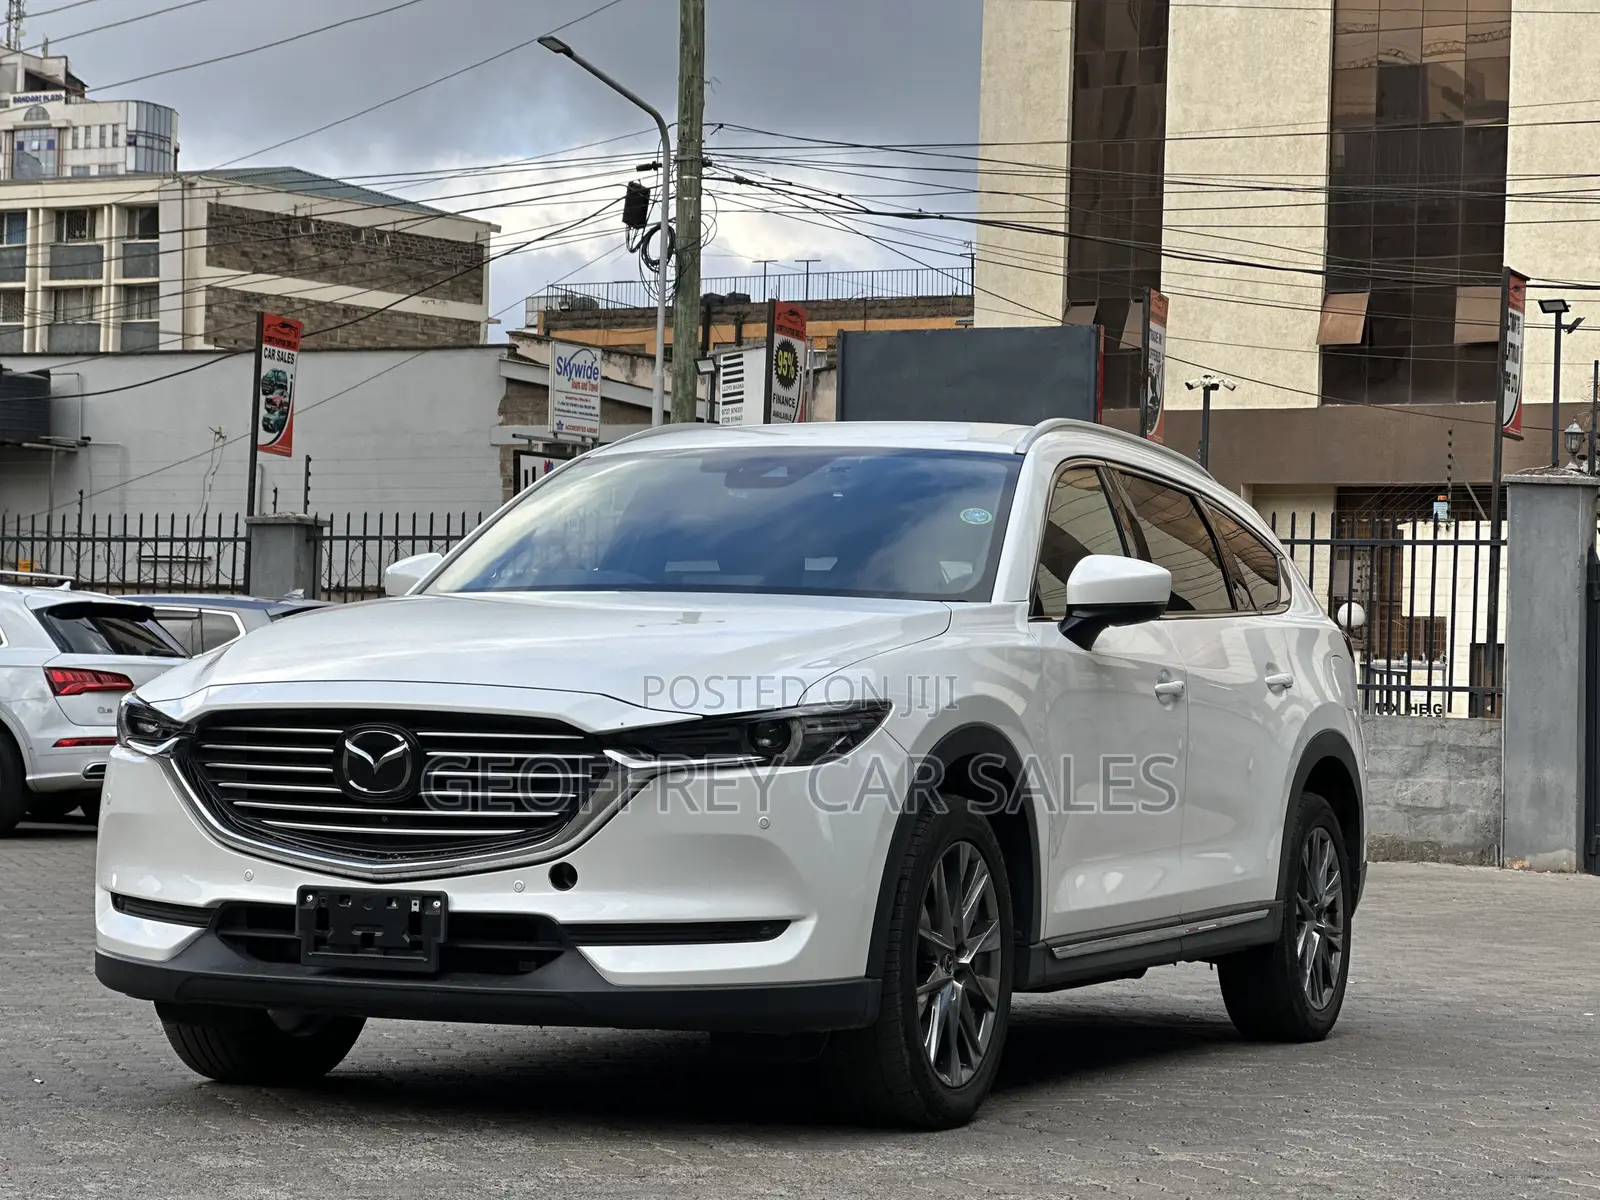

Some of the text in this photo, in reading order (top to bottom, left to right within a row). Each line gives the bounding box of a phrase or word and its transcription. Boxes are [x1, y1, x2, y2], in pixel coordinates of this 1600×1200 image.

[263, 347, 295, 365] CAR SALES
[777, 350, 795, 379] 95%
[556, 356, 600, 382] Skywide
[772, 393, 796, 408] FINANCE
[772, 410, 792, 421] AVAILABLE
